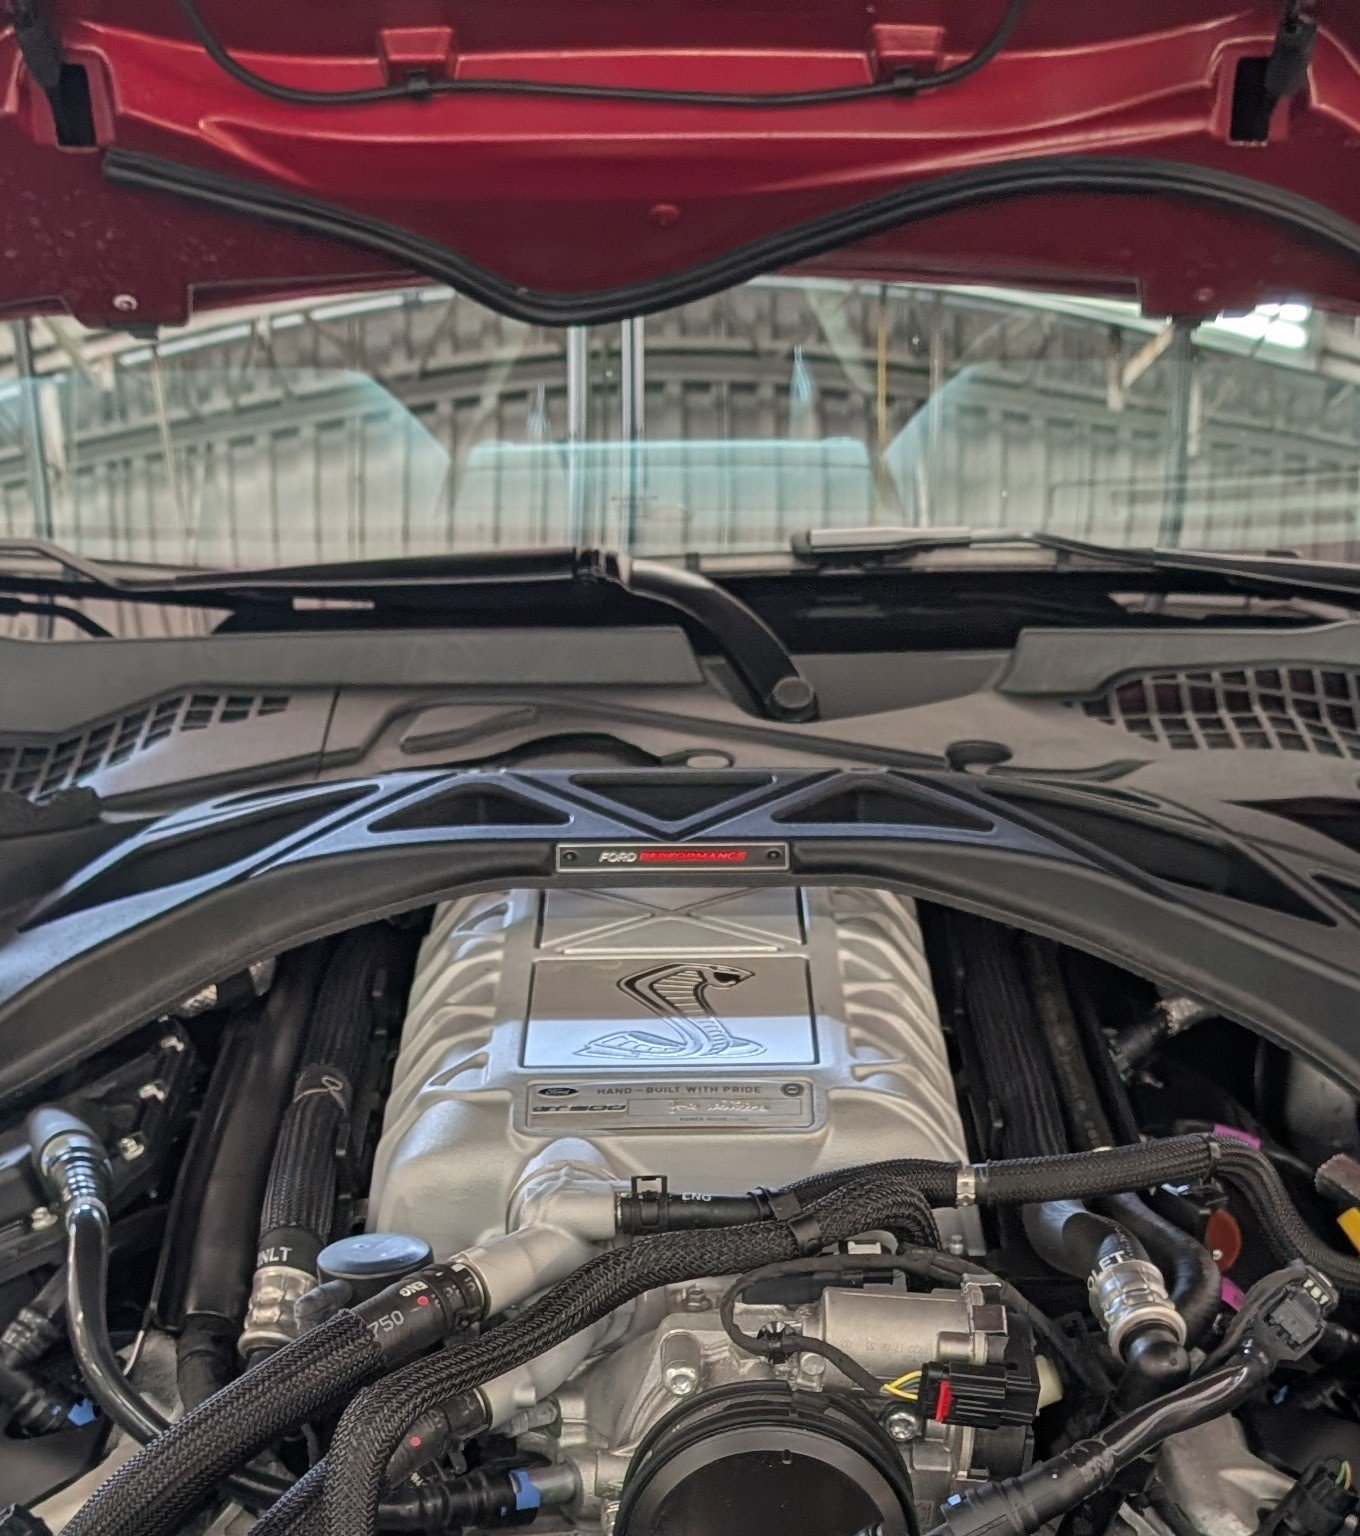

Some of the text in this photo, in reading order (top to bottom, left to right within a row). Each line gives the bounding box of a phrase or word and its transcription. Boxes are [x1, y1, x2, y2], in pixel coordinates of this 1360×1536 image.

[599, 850, 747, 863] FORD PERFORMANCE
[597, 1087, 632, 1095] HAND
[646, 1086, 680, 1095] BUILT
[685, 1086, 719, 1094] WITH
[723, 1085, 762, 1094] PRIDE
